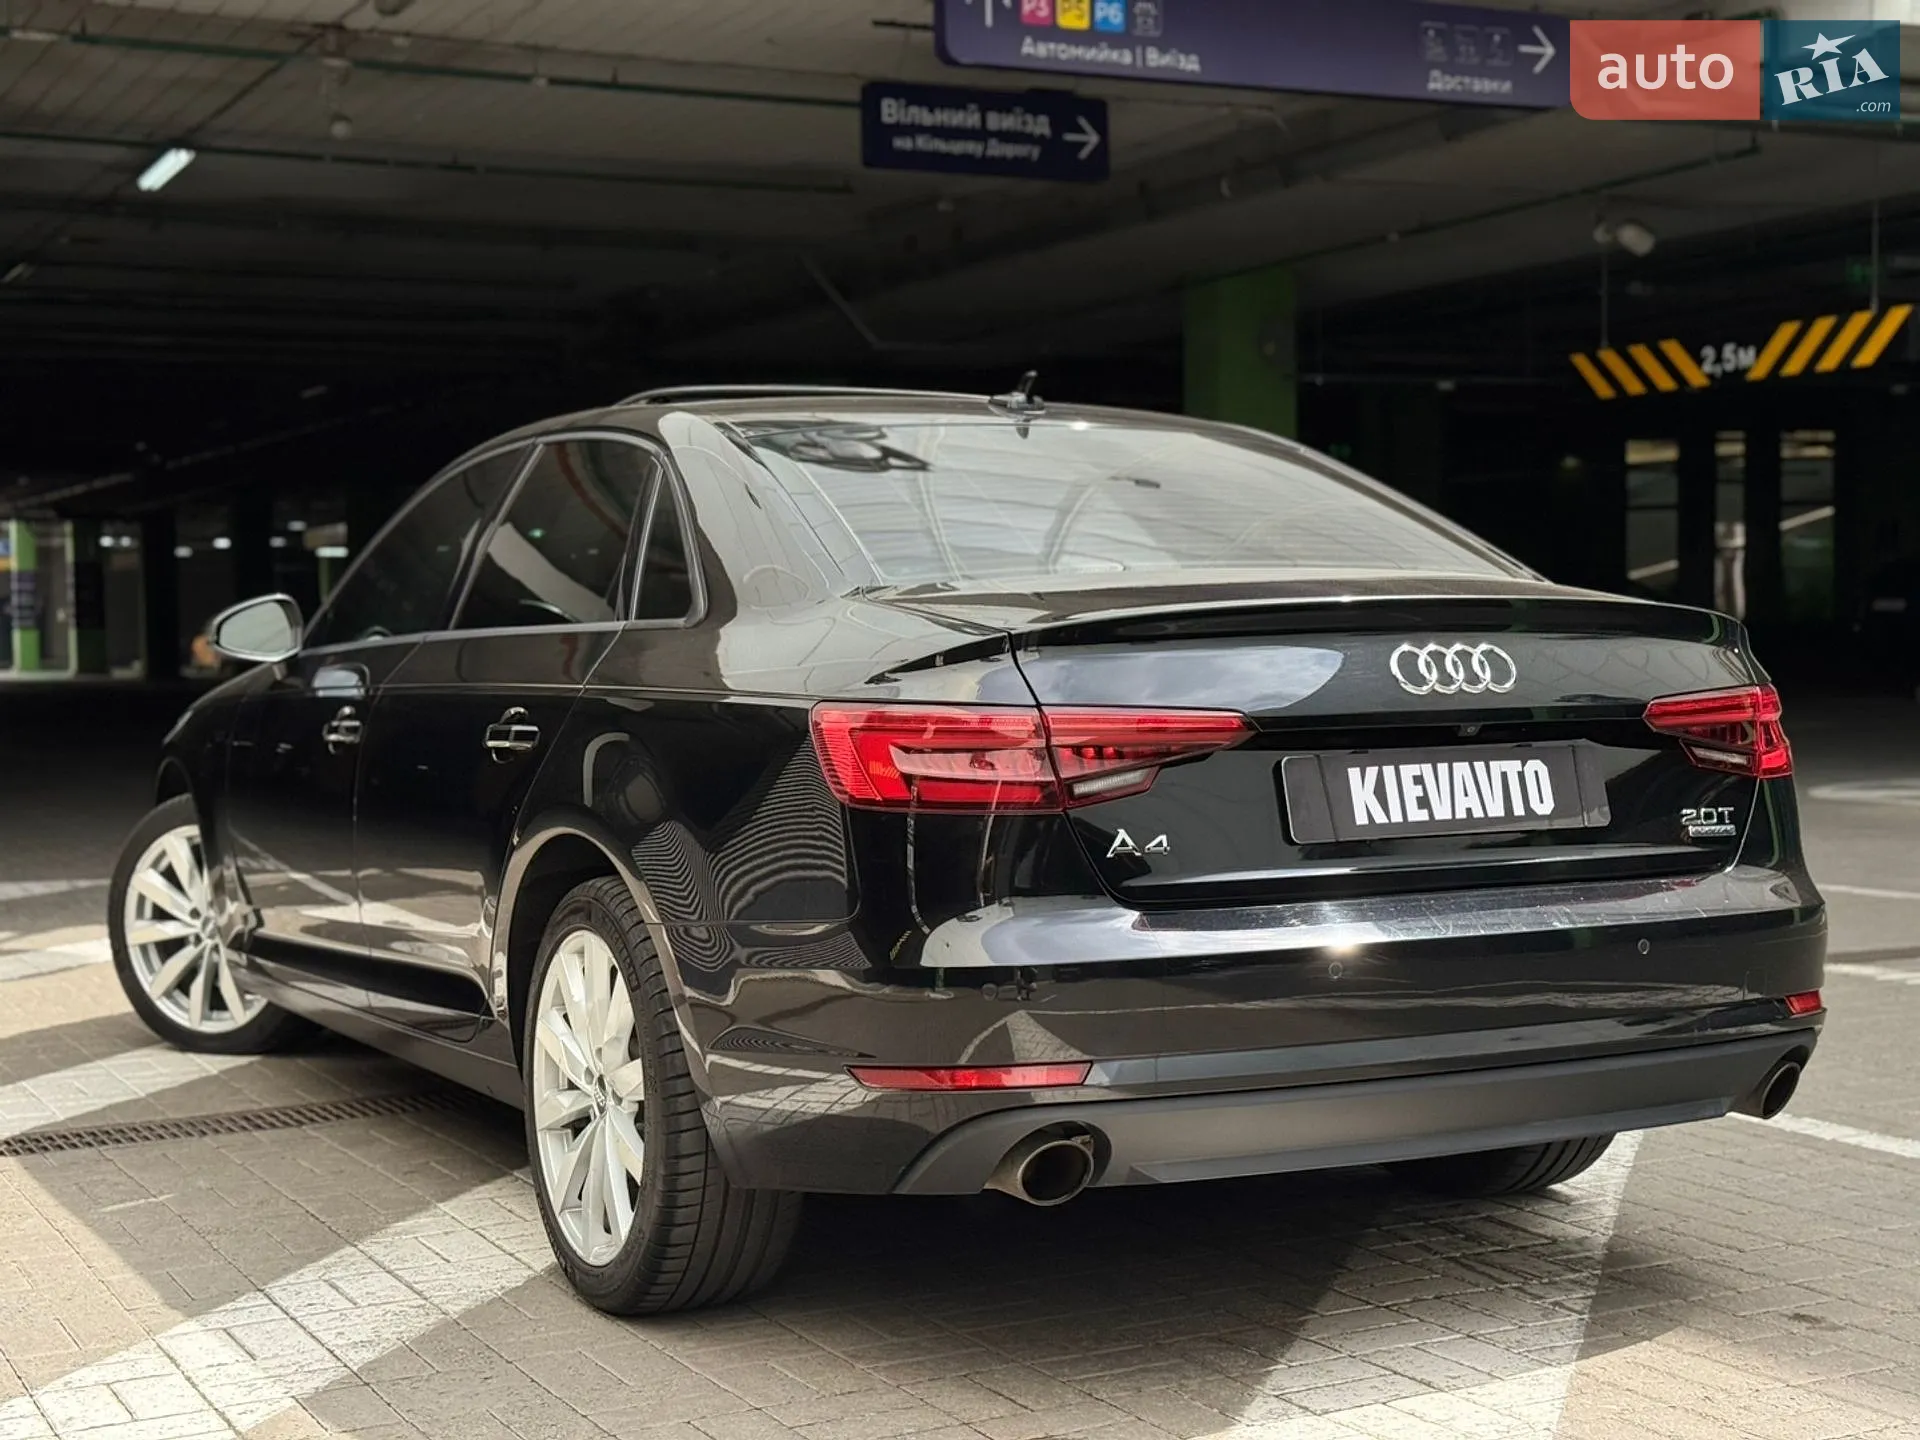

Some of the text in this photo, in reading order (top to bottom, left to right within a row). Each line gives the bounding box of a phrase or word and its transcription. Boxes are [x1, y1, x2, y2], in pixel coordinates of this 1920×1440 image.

[1094, 2, 1125, 25] P6
[880, 97, 1051, 138] Вільний виїзд
[1347, 759, 1555, 826] KIEVAVTO
[1106, 828, 1171, 858] A4
